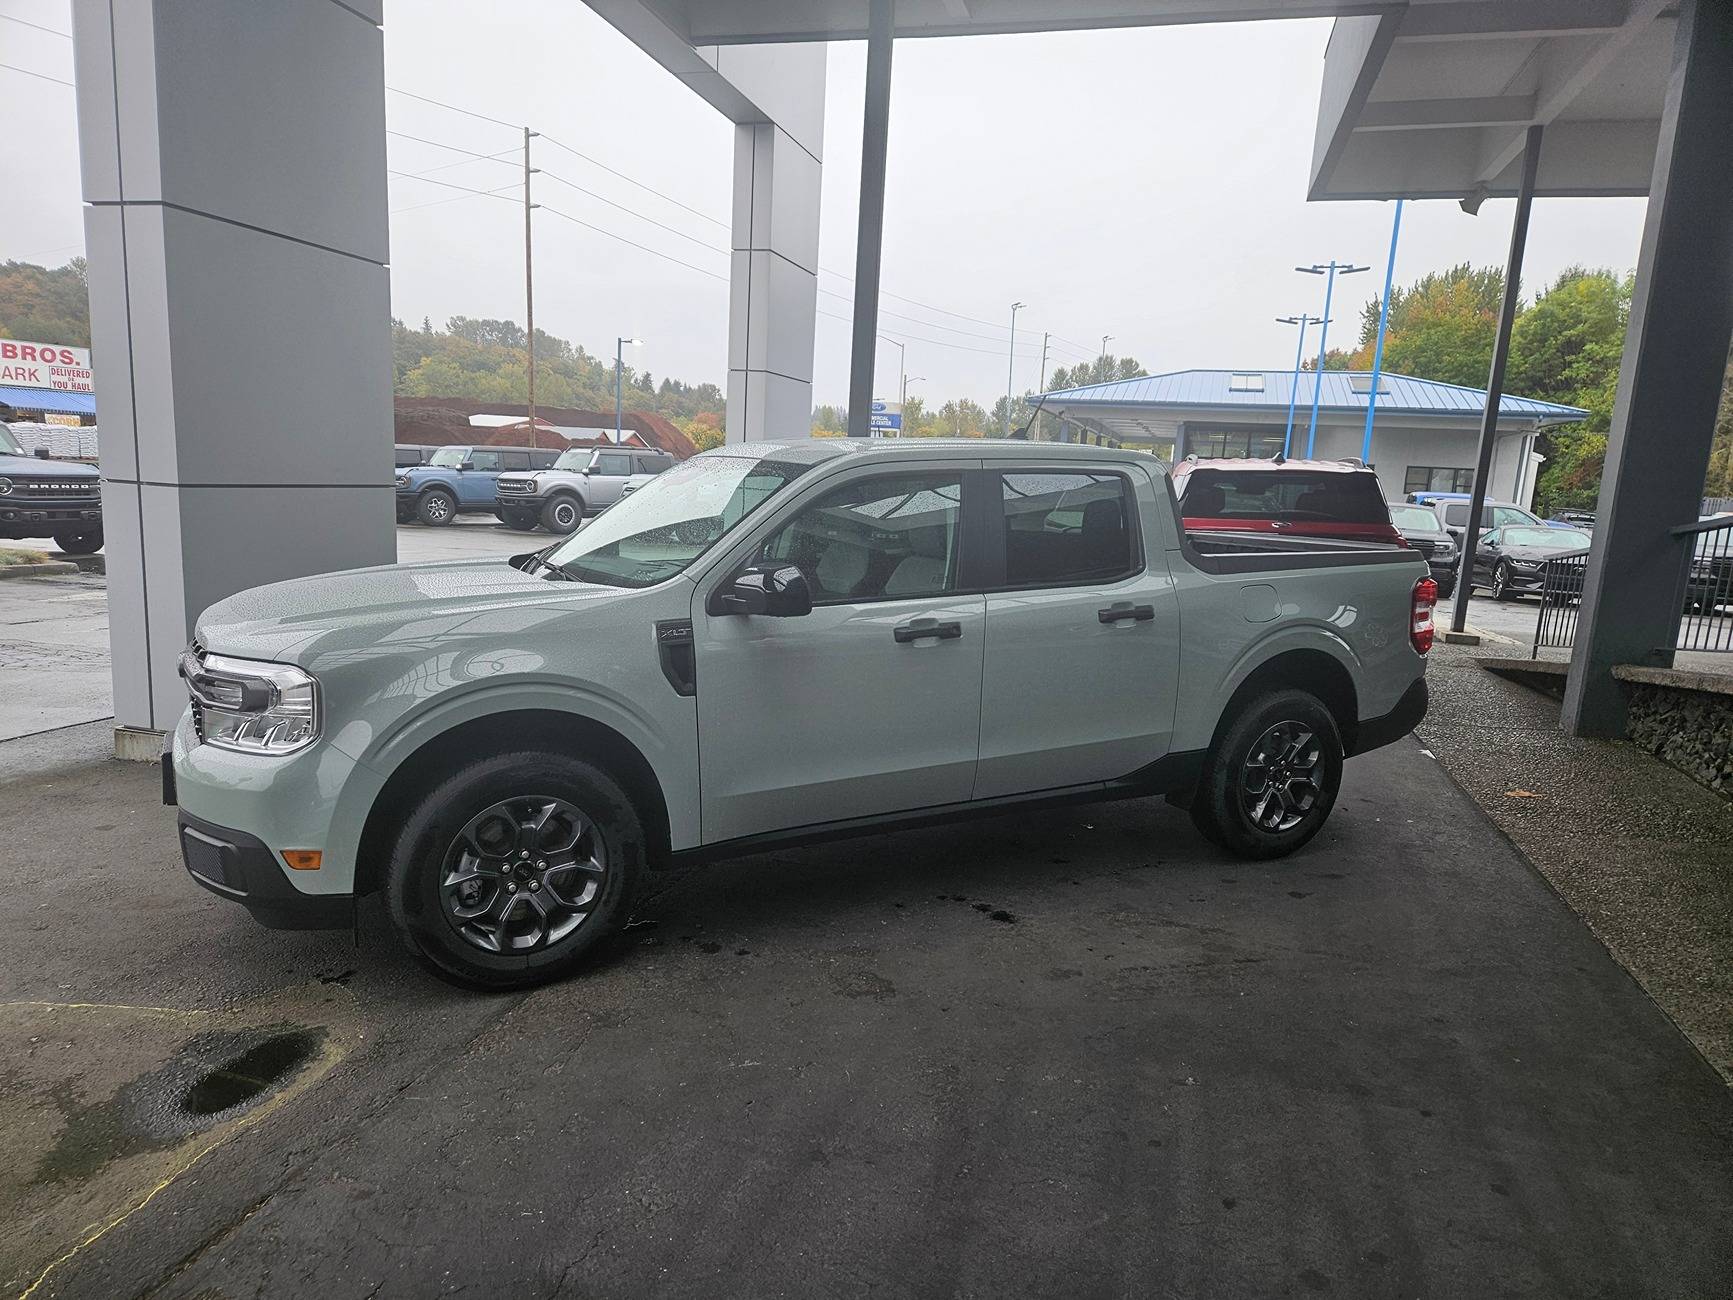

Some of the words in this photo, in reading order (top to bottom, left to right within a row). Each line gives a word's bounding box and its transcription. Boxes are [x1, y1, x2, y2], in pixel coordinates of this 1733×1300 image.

[1, 343, 81, 366] BROS.
[51, 367, 91, 379] DELIVERED
[52, 380, 68, 389] YOU
[71, 382, 91, 391] HAUL
